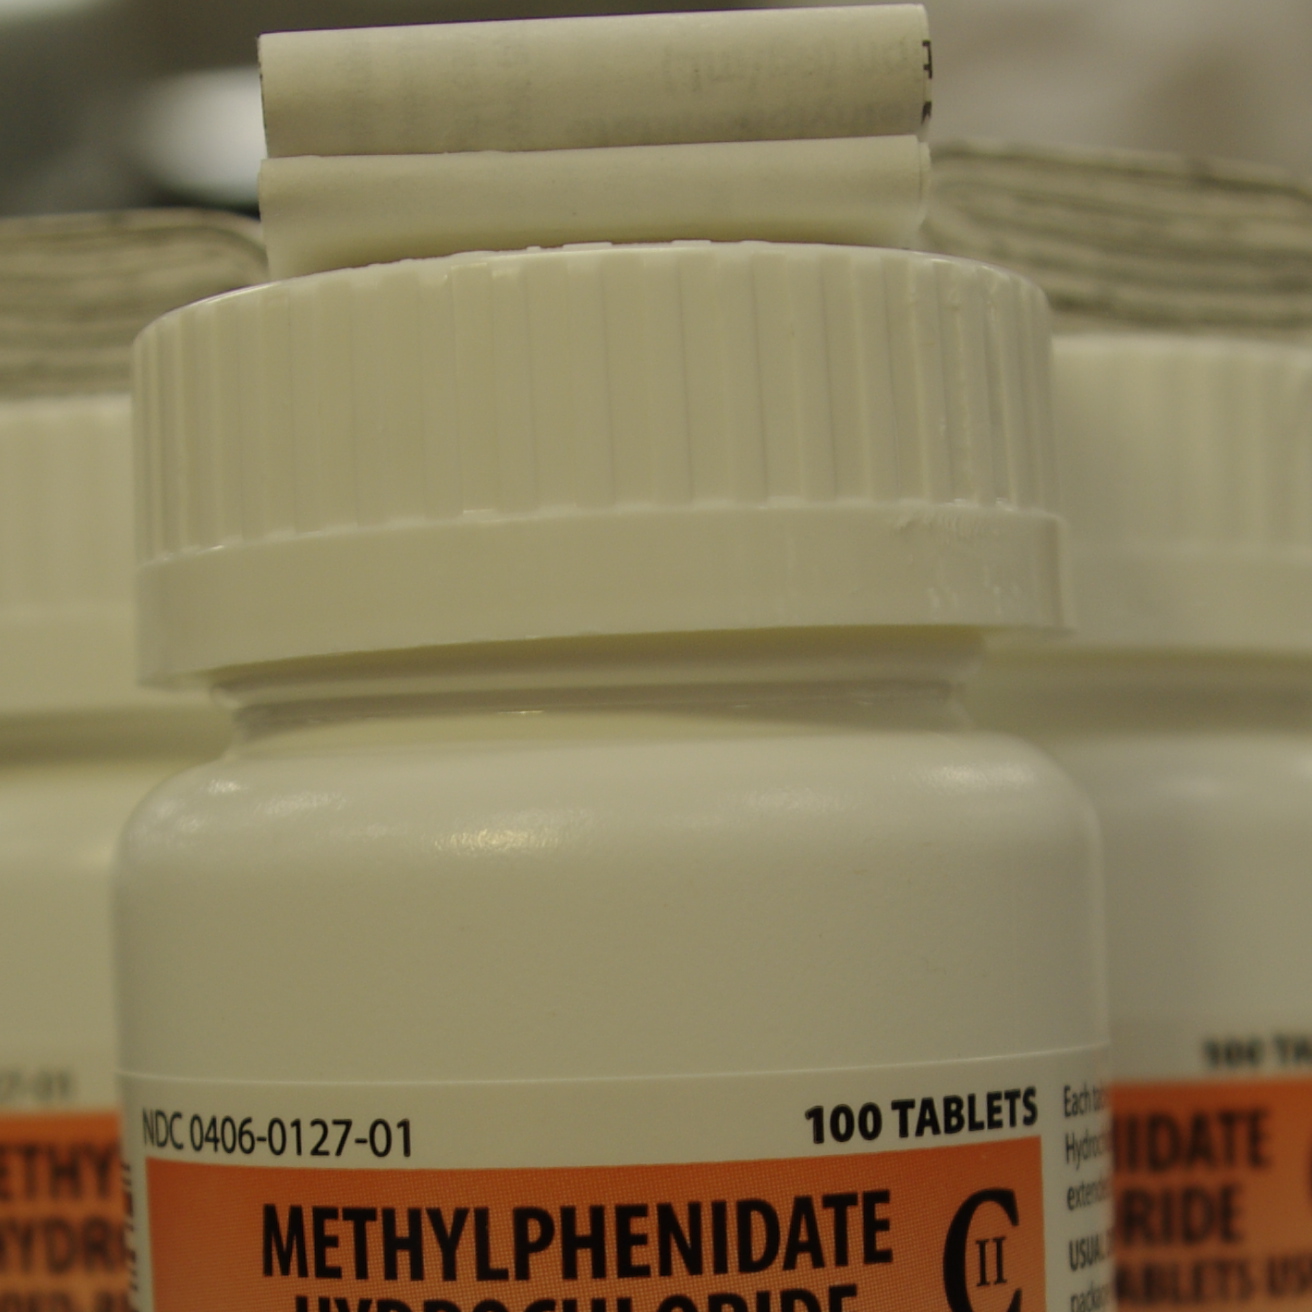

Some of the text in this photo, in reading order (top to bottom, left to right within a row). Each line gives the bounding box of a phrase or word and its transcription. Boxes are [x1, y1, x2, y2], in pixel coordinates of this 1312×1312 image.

[142, 1108, 413, 1158] NDC 0406-0127-01
[804, 1086, 1039, 1145] 100 TABLETS
[262, 1189, 894, 1281] METHYLPHENIDATE
